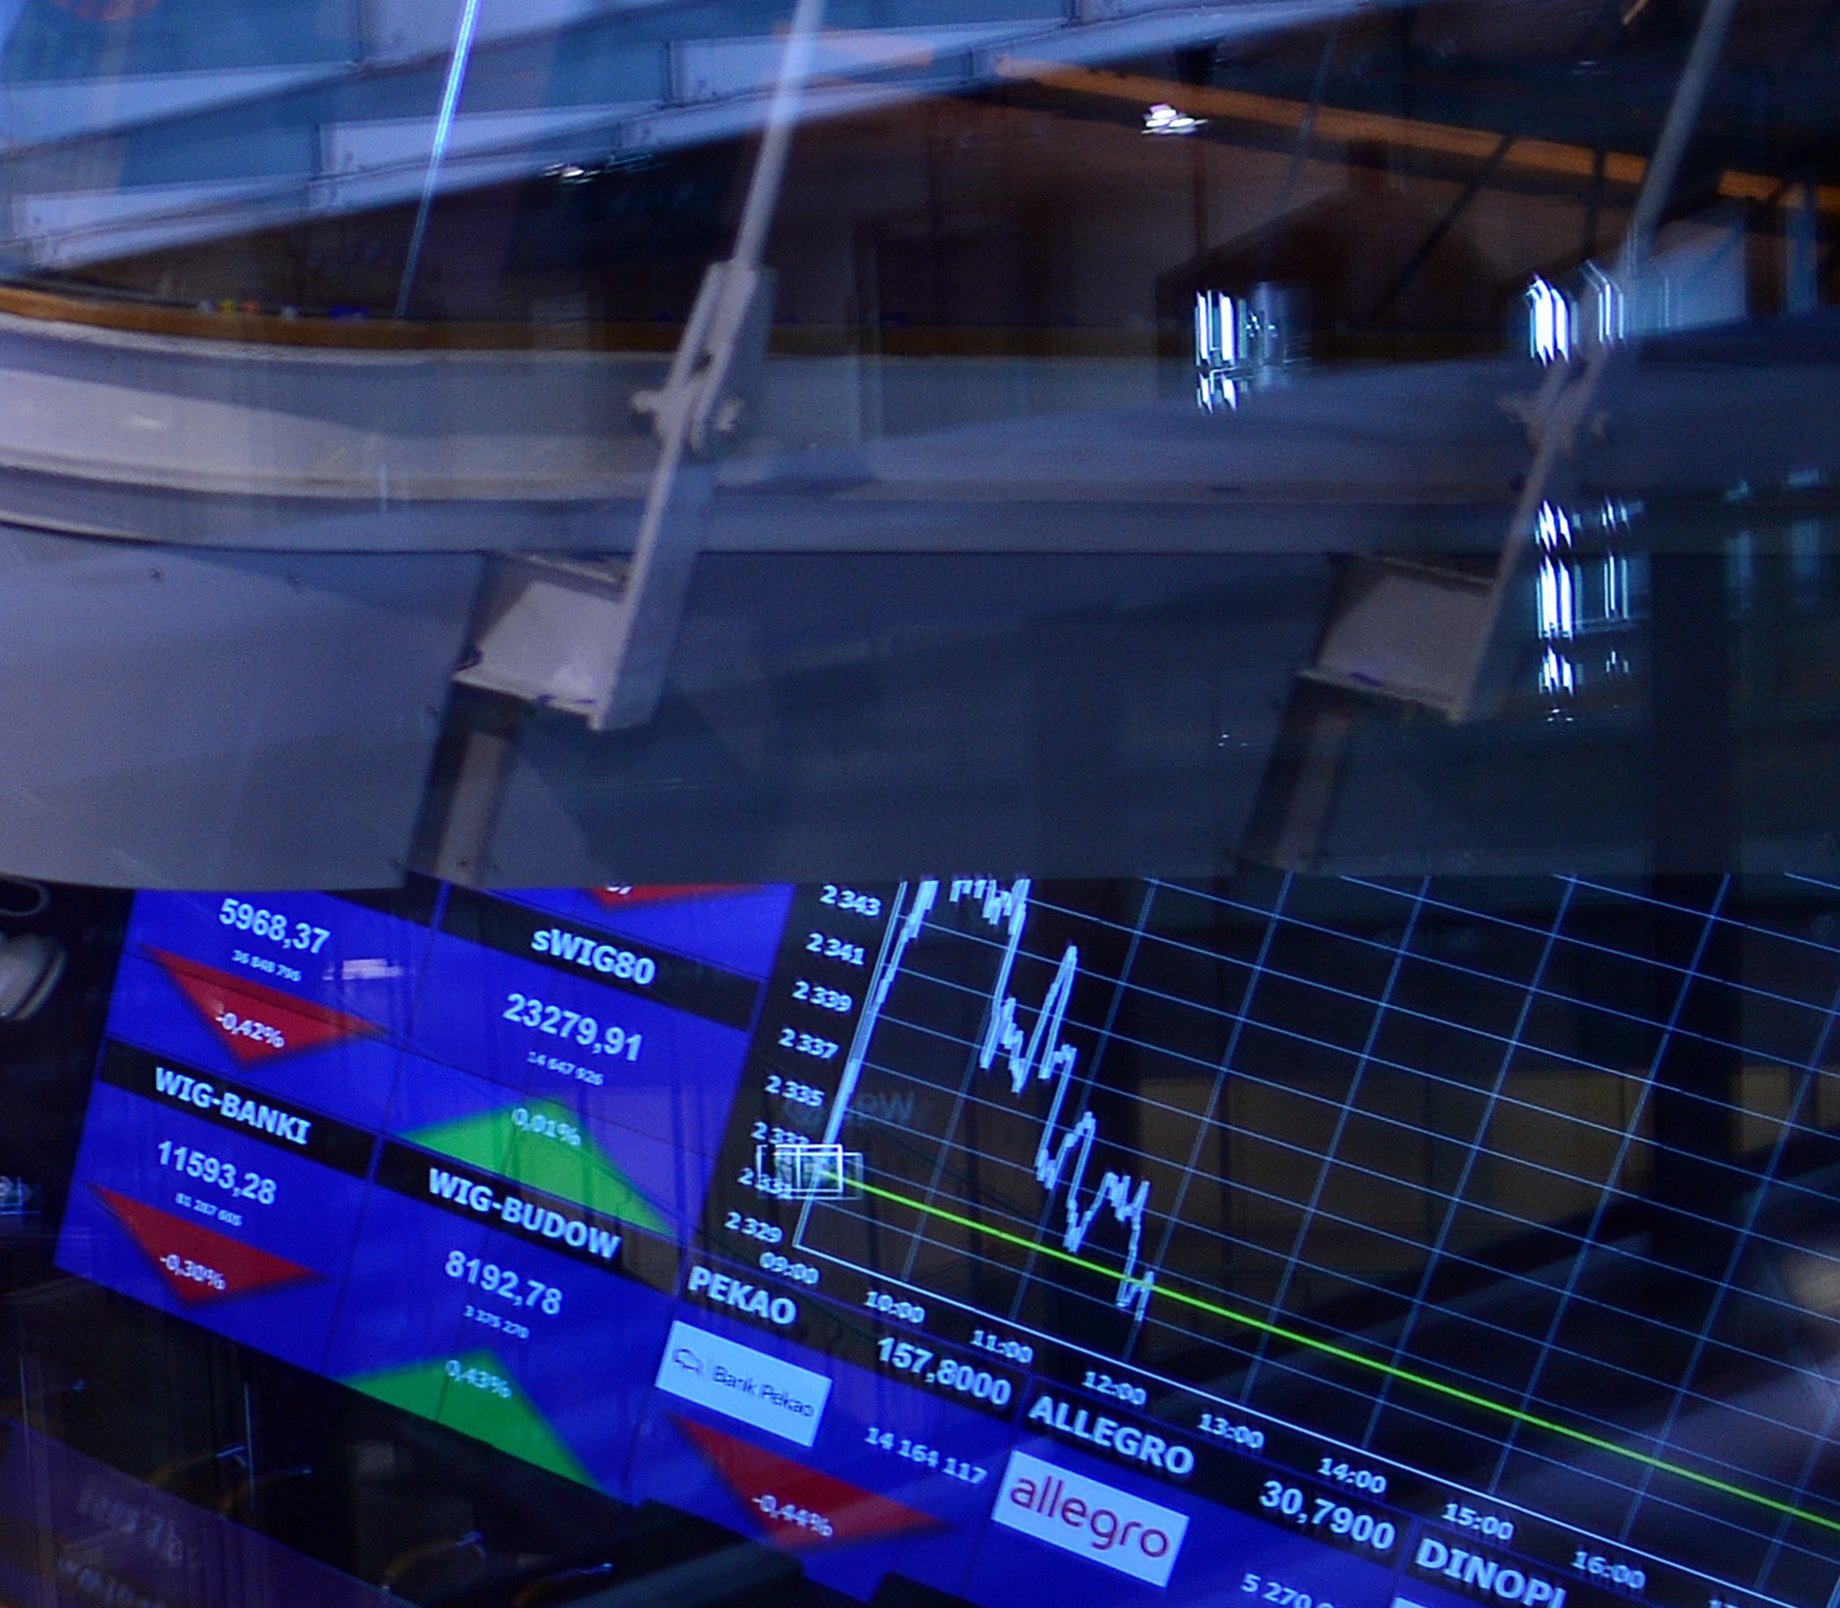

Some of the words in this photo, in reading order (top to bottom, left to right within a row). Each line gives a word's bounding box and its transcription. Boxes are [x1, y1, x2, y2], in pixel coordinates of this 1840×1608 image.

[838, 890, 882, 916] 343
[219, 898, 330, 953] 5968,37
[530, 928, 656, 985] sWIG80
[824, 938, 865, 966] 341
[810, 986, 852, 1012] 339
[215, 1012, 285, 1048] -0,42%
[503, 993, 642, 1061] 23279,91
[796, 1034, 839, 1059] 337
[155, 1067, 312, 1145] WIG-BANKI
[782, 1081, 825, 1107] 335
[158, 1140, 277, 1205] 11593,28
[429, 1168, 622, 1259] WIG-BUDOW
[742, 1218, 783, 1243] 329
[444, 1250, 563, 1315] 8192,78
[759, 1252, 820, 1285] 09:00
[688, 1265, 797, 1325] PEKAO
[864, 1291, 926, 1324] 10:00
[970, 1330, 1033, 1364] 11:00
[877, 1337, 1012, 1405] 157,8000
[1082, 1371, 1147, 1406] 12:00
[713, 1365, 757, 1396] Bank
[759, 1382, 815, 1418] Pekao
[1027, 1396, 1195, 1475] ALLEGRO
[1196, 1412, 1265, 1450] 13:00
[865, 1427, 895, 1451] 14
[942, 1457, 988, 1485] 117
[1317, 1457, 1387, 1494] 14:00
[1010, 1474, 1171, 1560] allegro
[1259, 1480, 1398, 1551] 30,7900
[1441, 1503, 1515, 1541] 15:00
[1240, 1573, 1261, 1595] 5
[1571, 1550, 1646, 1590] 16:00
